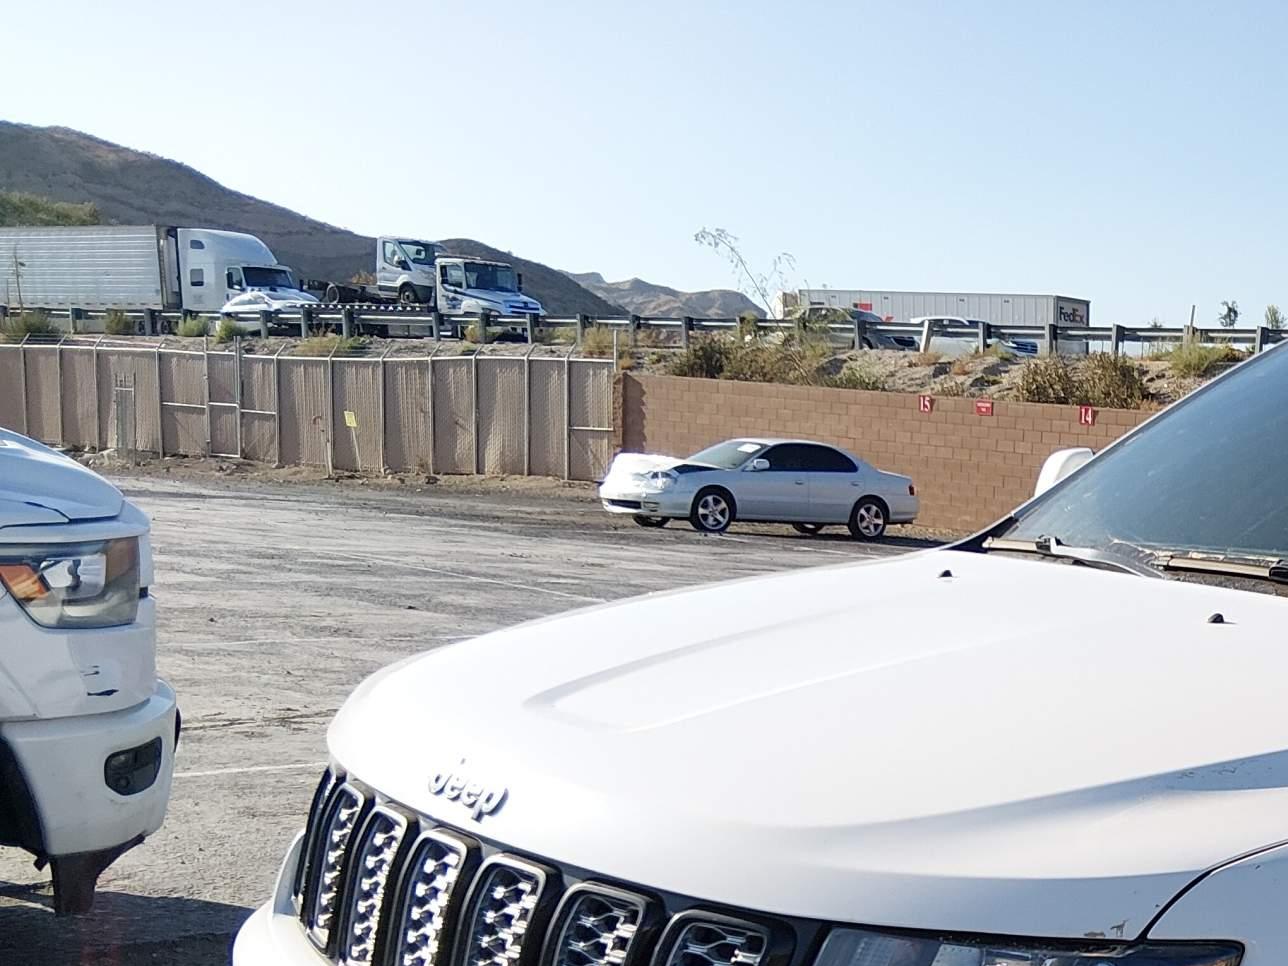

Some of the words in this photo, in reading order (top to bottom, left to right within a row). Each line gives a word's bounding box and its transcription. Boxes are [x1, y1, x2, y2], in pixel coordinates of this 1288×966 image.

[1059, 306, 1085, 325] FedEx
[919, 396, 931, 412] 15
[1081, 407, 1092, 424] 14
[427, 757, 510, 824] Jeep
